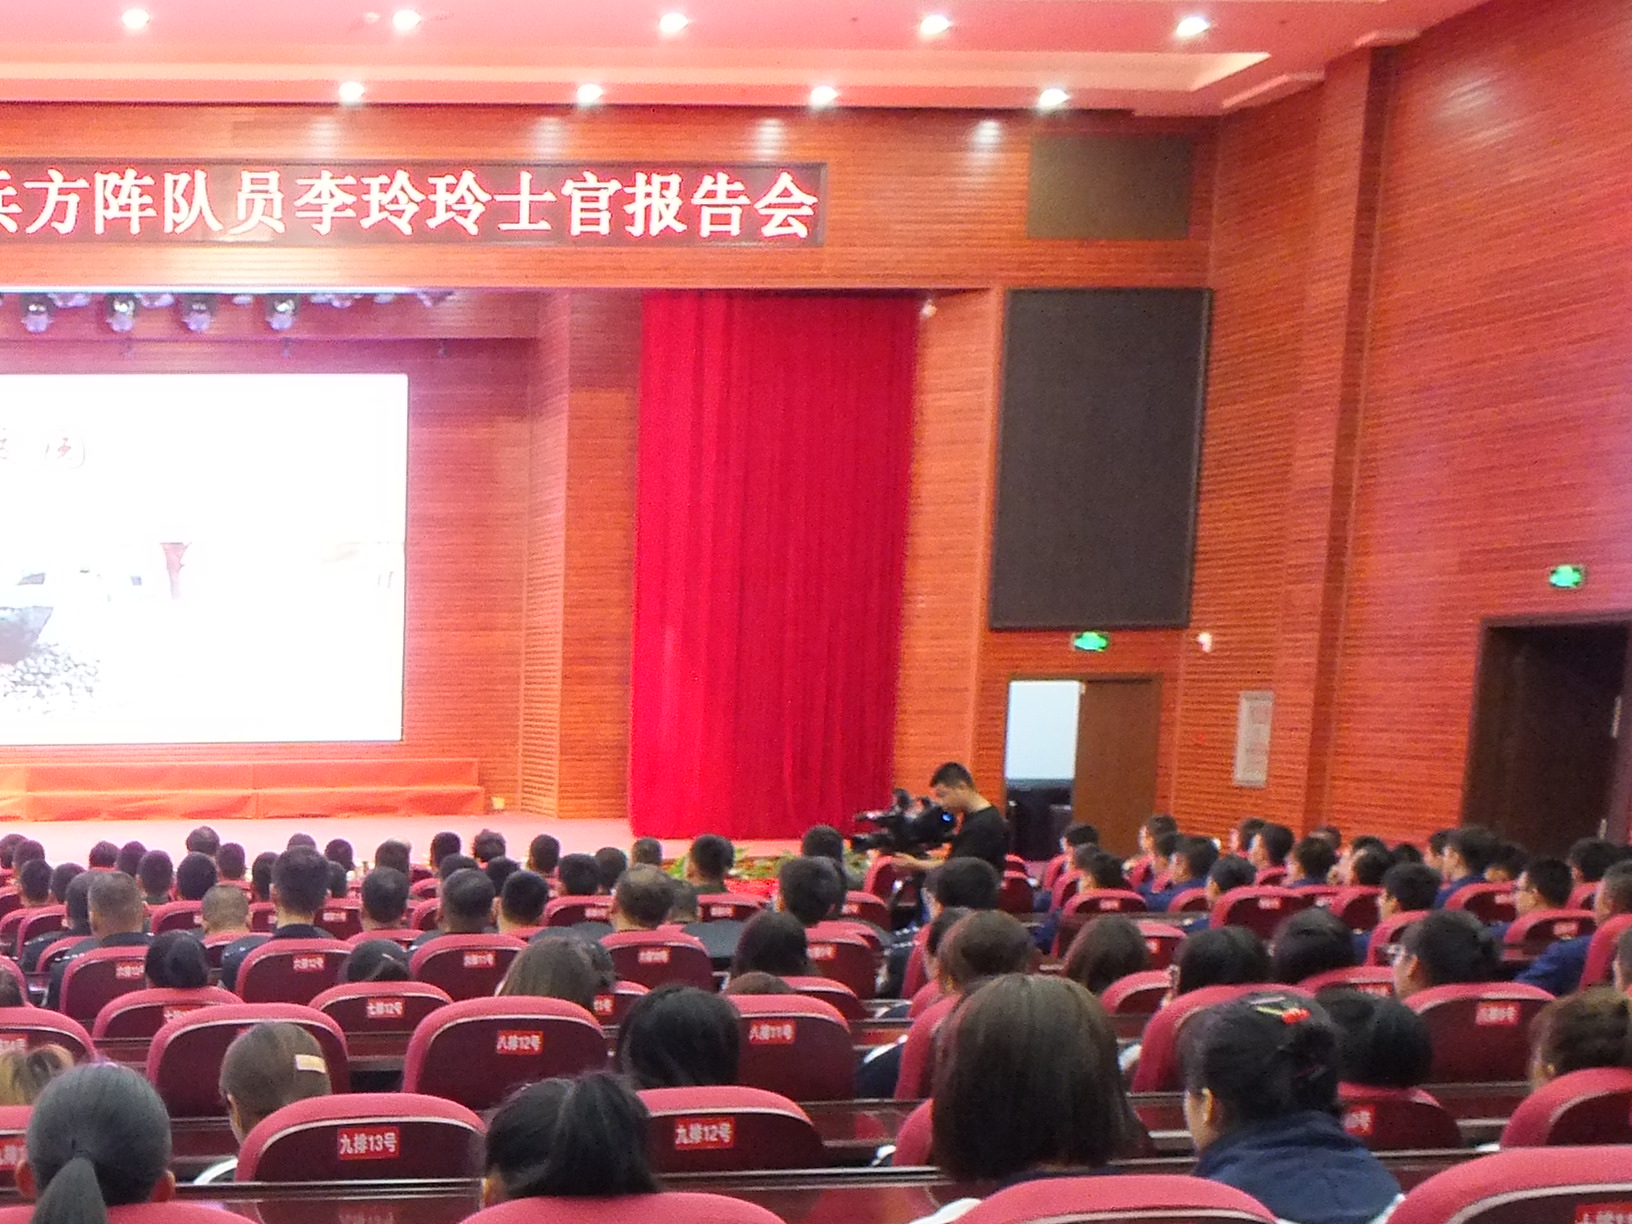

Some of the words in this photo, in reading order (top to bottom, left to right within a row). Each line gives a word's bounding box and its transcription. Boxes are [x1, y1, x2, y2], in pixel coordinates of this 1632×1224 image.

[339, 1131, 398, 1156] 九排13号
[674, 1121, 733, 1146] 九排12号
